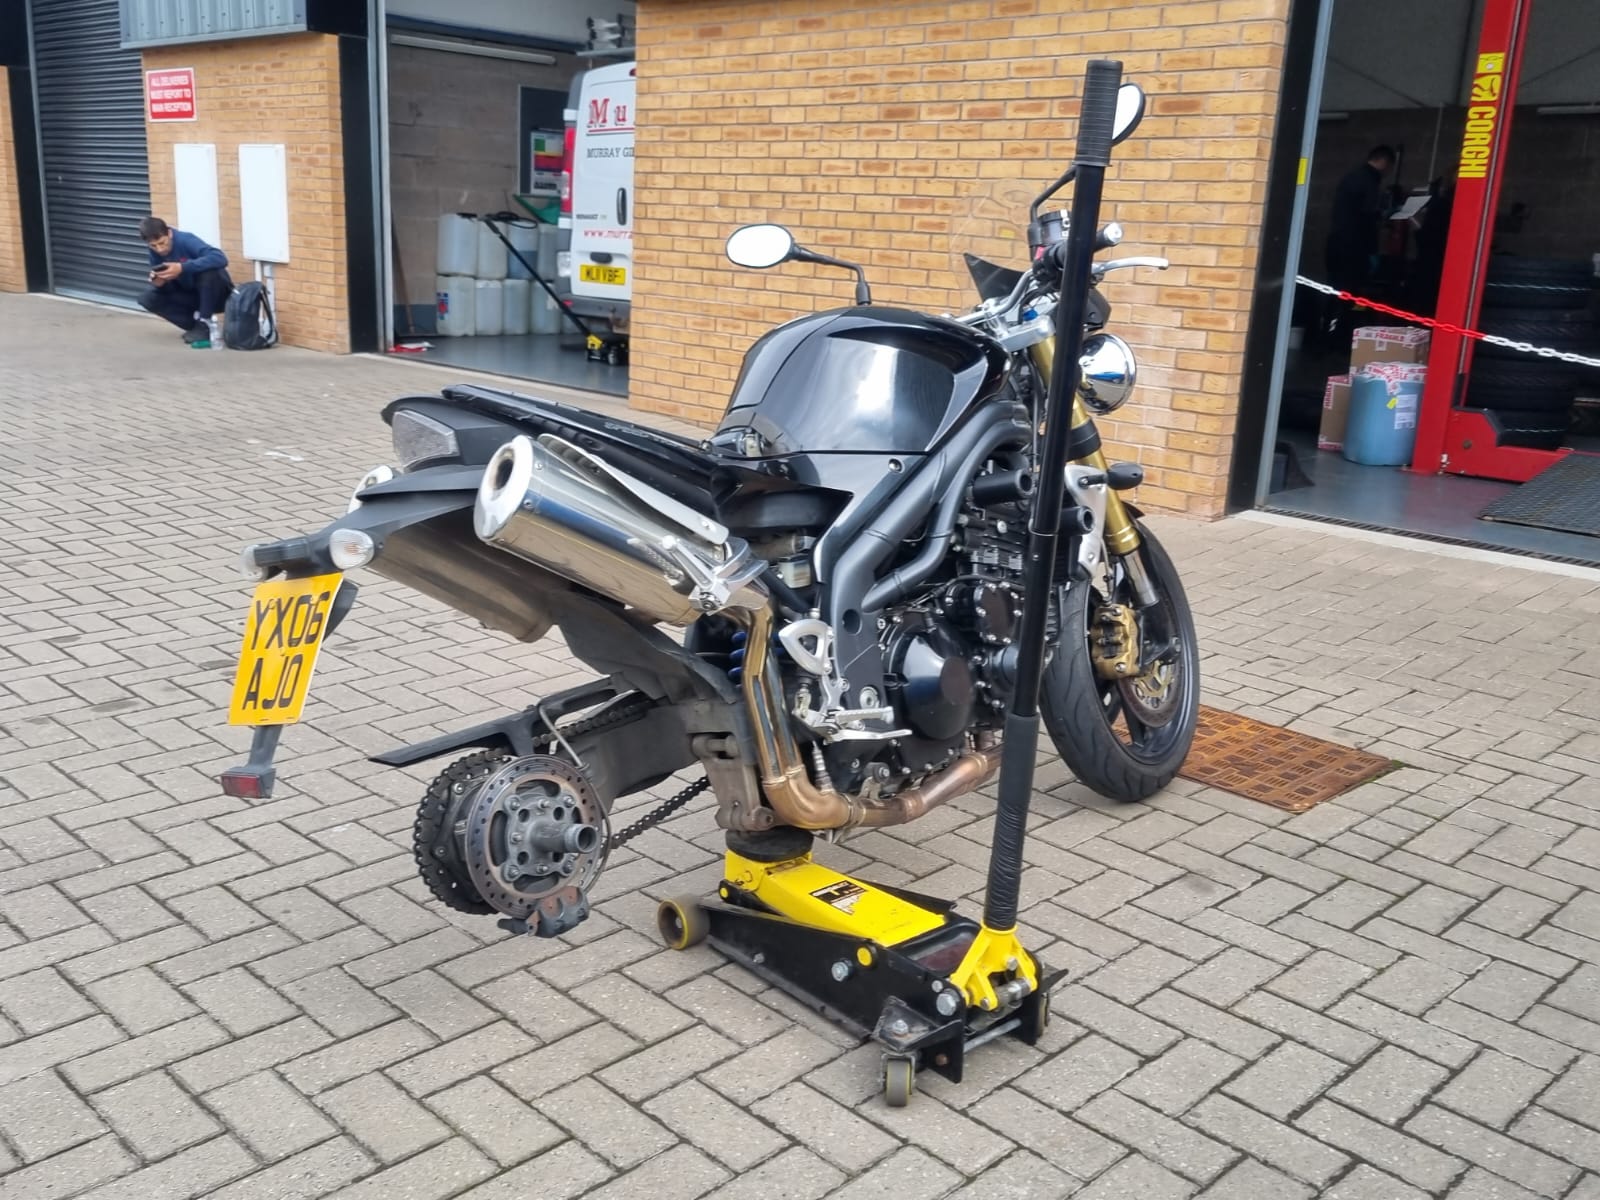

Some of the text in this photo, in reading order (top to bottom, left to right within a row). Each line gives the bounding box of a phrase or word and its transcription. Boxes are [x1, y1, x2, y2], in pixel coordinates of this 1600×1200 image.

[587, 147, 621, 158] MURRAY
[1458, 106, 1497, 178] CORGHI
[250, 590, 331, 650] YX06
[242, 654, 304, 710] AJO
